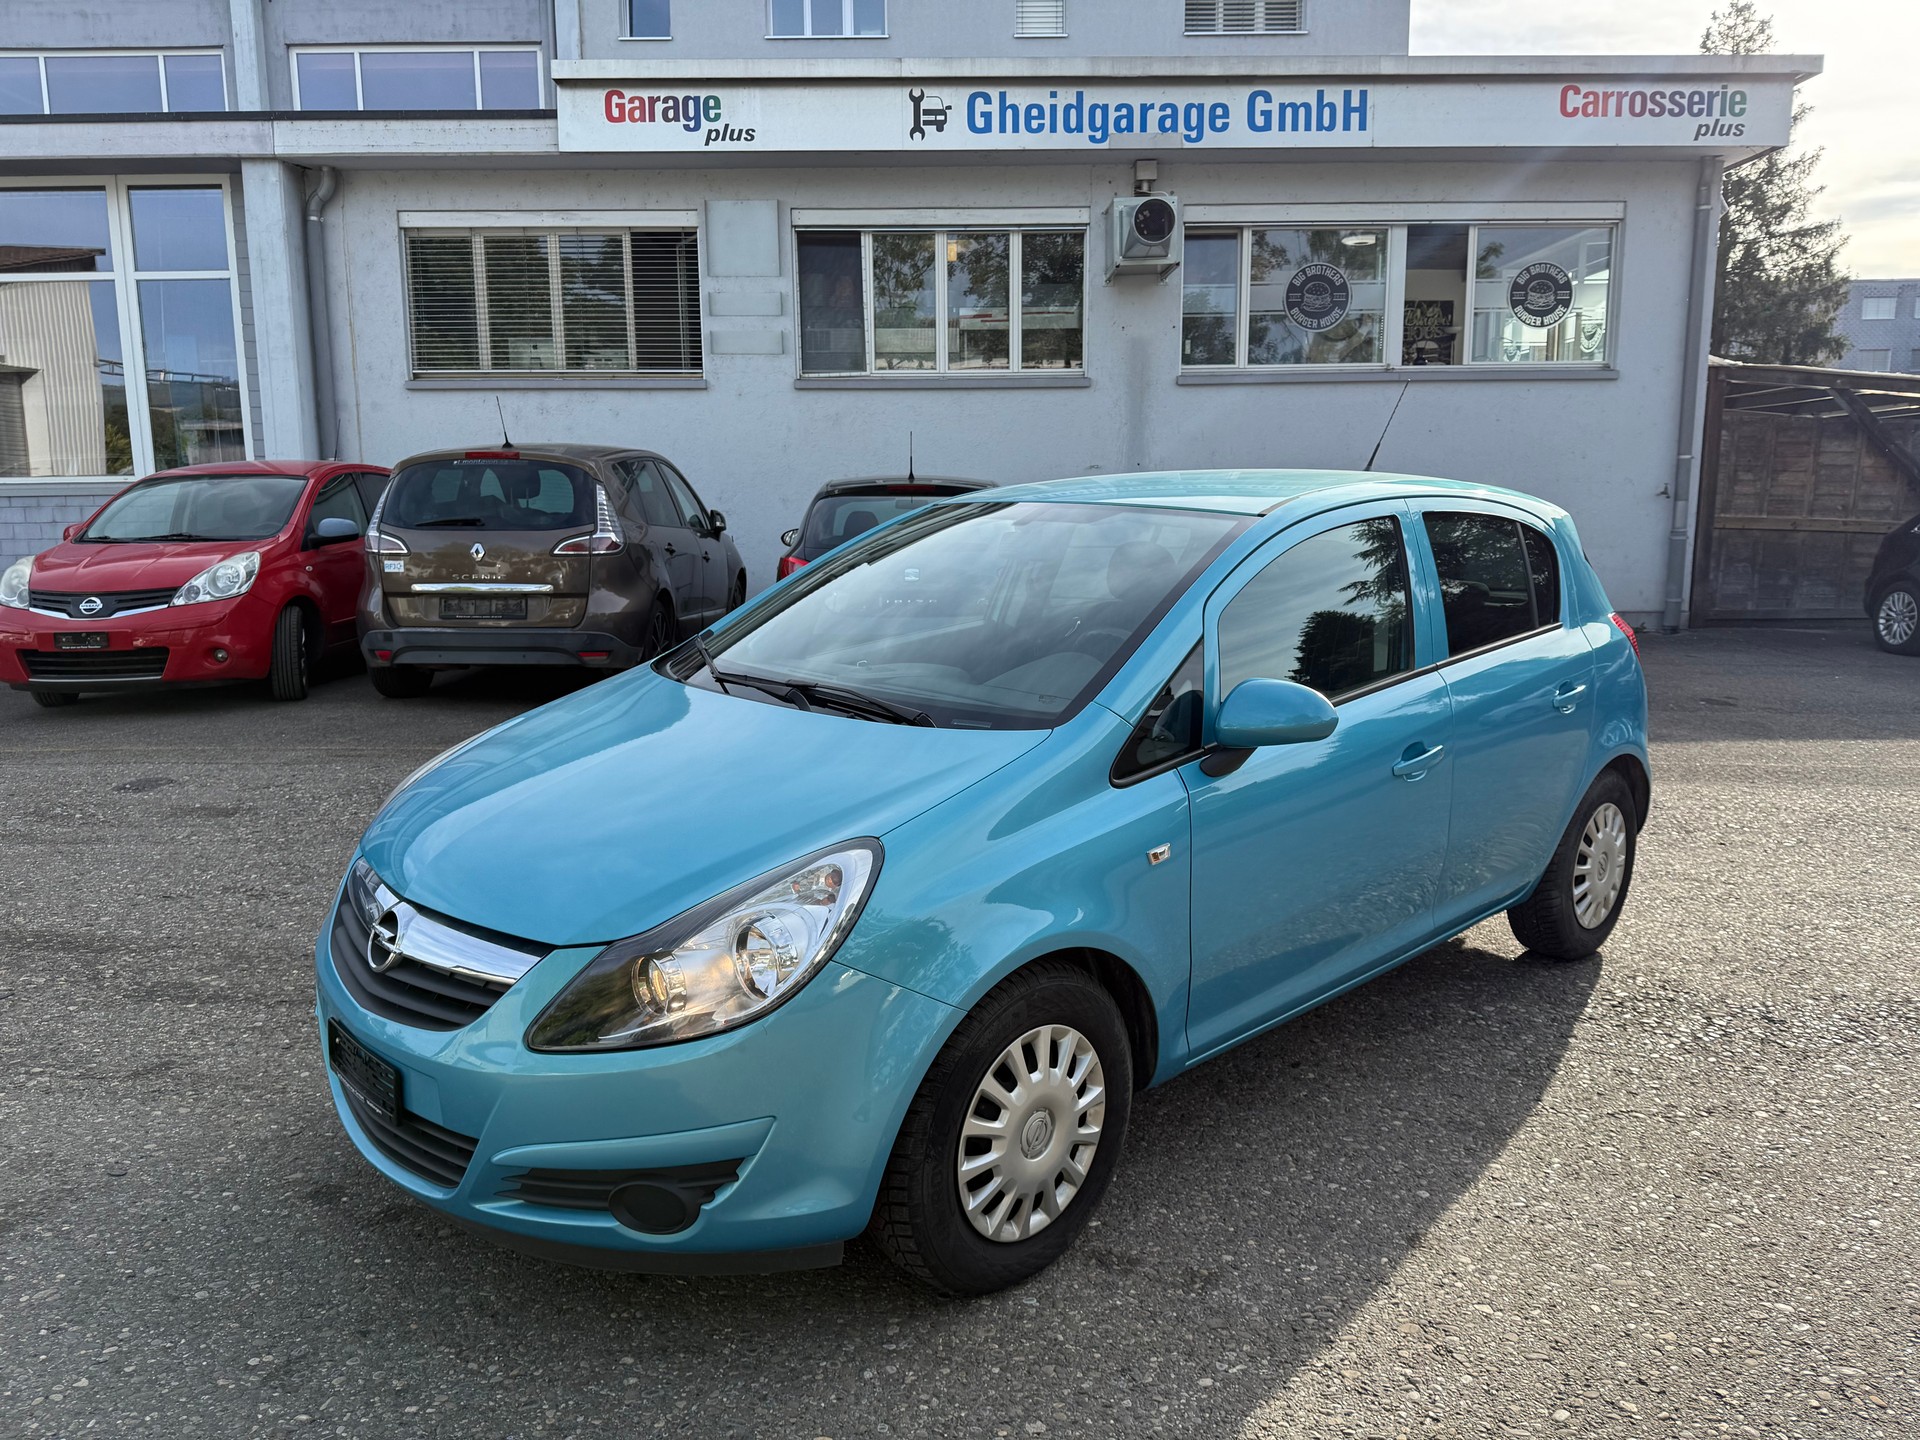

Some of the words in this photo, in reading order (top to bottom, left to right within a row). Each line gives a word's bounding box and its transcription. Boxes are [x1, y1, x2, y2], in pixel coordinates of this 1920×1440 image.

[604, 89, 721, 132] Garage
[1559, 84, 1747, 118] Carrosserie
[966, 90, 1230, 144] Gheidgarage
[1247, 89, 1368, 132] GmbH
[704, 123, 756, 146] plus
[1693, 118, 1746, 141] plus
[1292, 271, 1306, 286] BIG
[1305, 265, 1344, 286] BROTHERS
[1516, 270, 1530, 285] BIG
[1529, 263, 1568, 284] BROTHERS
[1290, 306, 1318, 328] BURGER
[1320, 306, 1344, 328] HOUSE
[1513, 304, 1542, 326] BURGER
[1542, 304, 1567, 326] HOUSE
